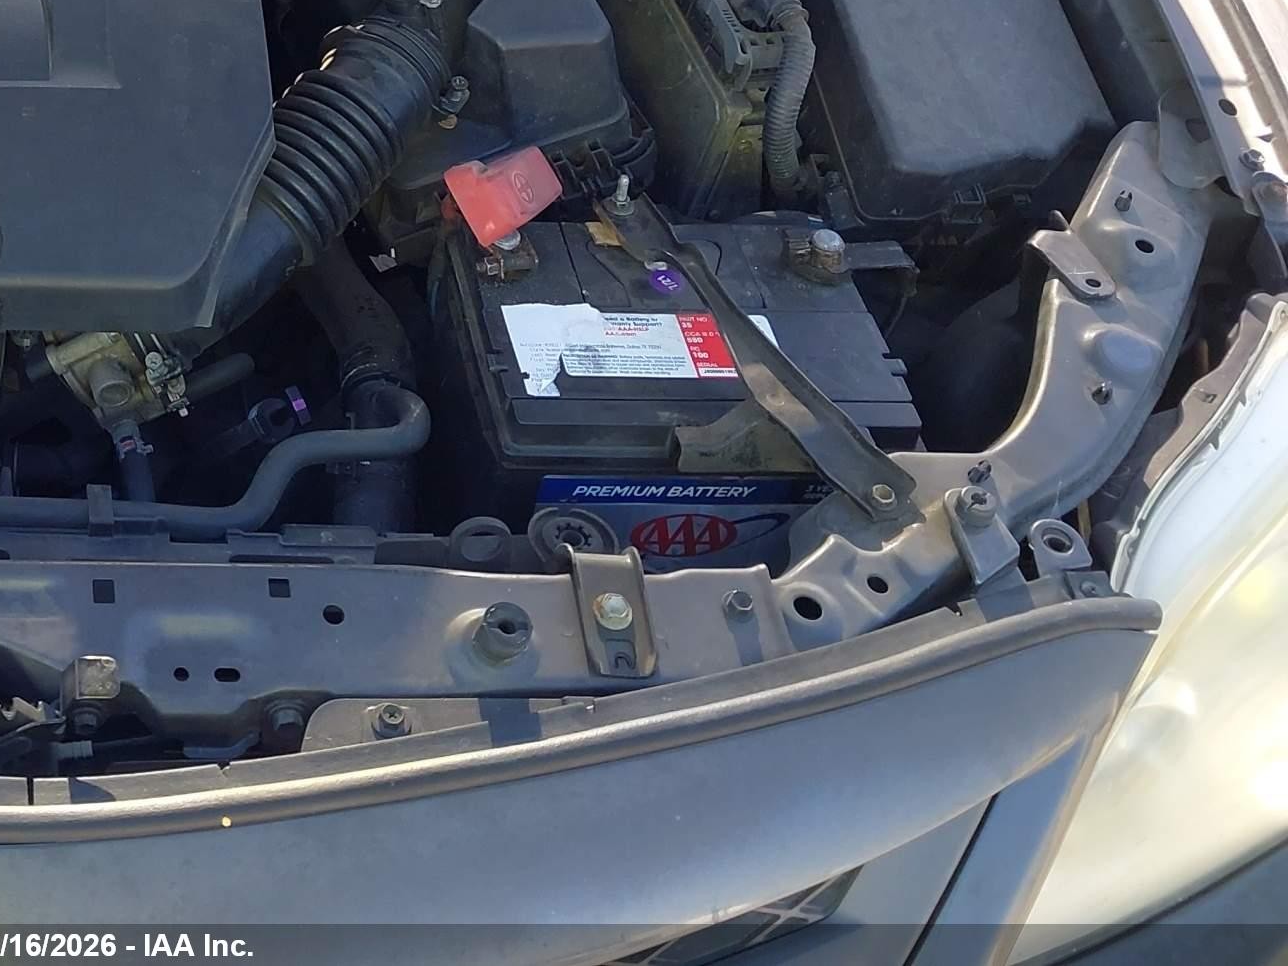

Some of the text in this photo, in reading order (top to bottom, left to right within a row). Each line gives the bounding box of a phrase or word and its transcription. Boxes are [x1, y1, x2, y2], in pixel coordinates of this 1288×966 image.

[572, 485, 757, 498] PREMIUM BATTERY
[634, 514, 735, 557] AAA
